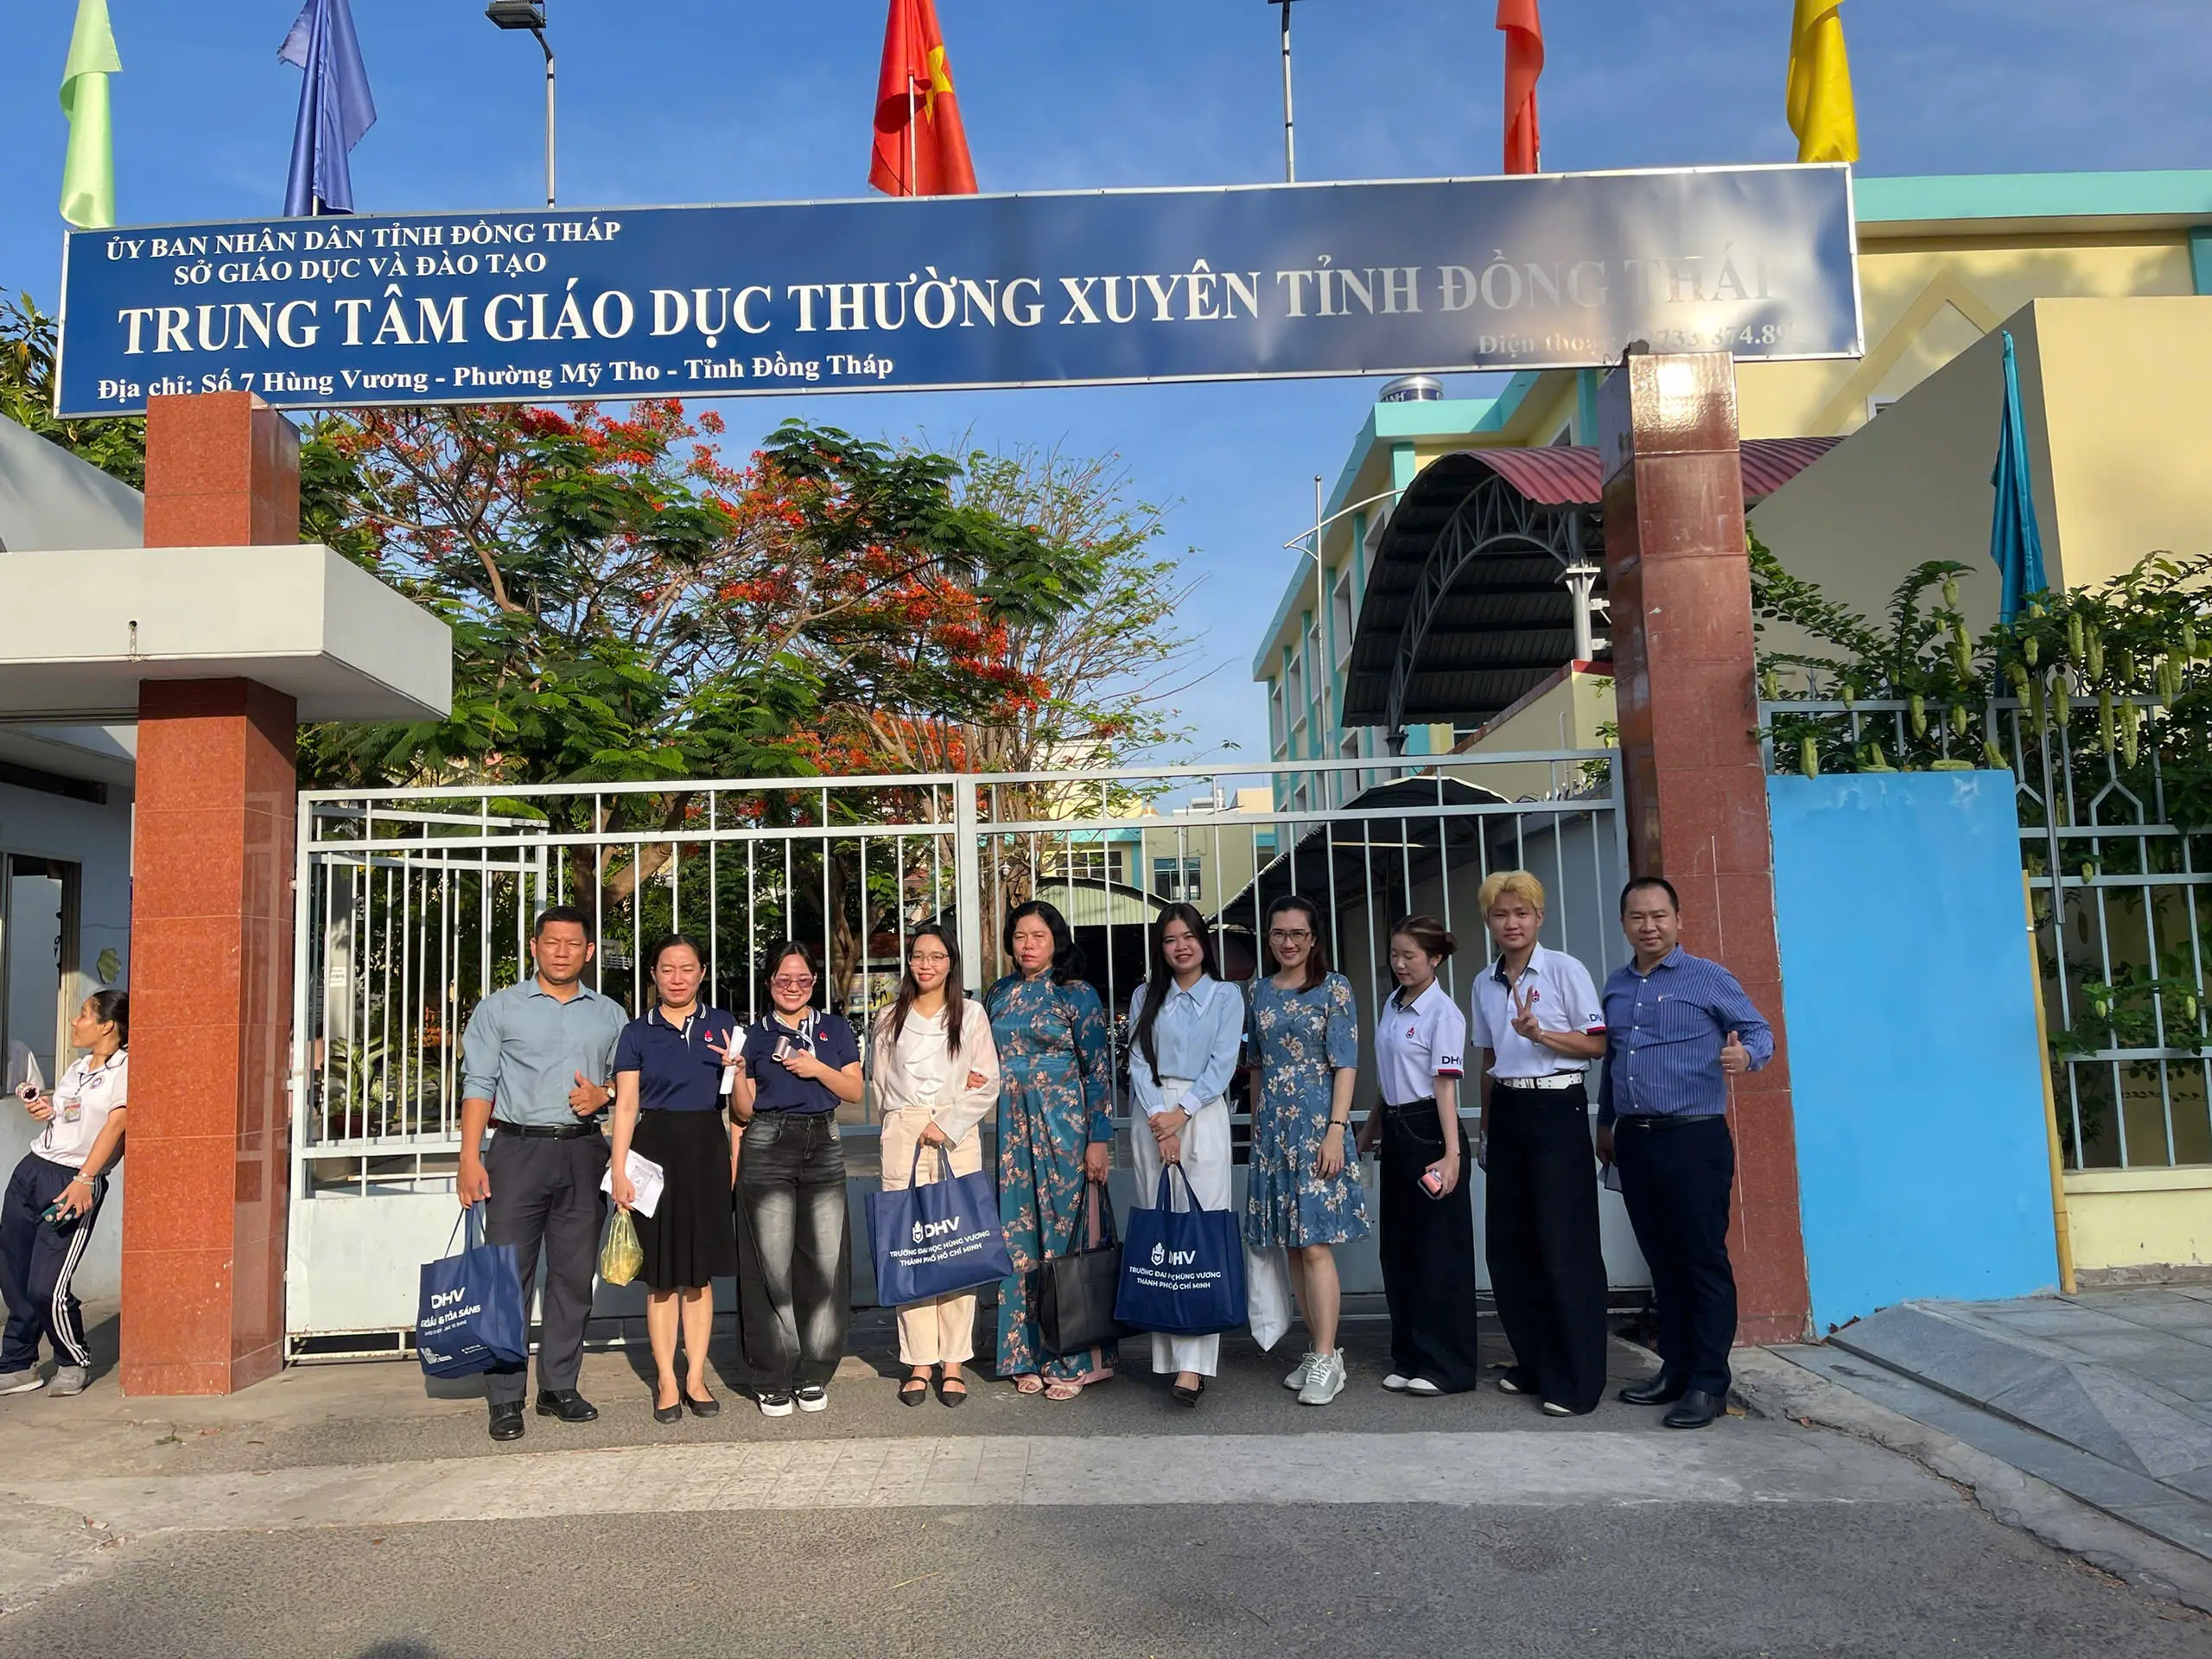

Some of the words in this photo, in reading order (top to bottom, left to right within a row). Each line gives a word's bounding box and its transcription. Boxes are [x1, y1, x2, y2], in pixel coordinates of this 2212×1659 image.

[106, 236, 145, 261] ỦY
[149, 236, 208, 257] BAN
[214, 227, 296, 253] NHÂN
[304, 225, 364, 250] DÂN
[372, 222, 443, 247] TỈNH
[450, 219, 536, 245] ĐỒNG
[542, 217, 621, 242] THÁP
[174, 259, 213, 285] SỞ
[218, 256, 292, 283] GIÁO
[299, 258, 360, 283] DỤC
[367, 251, 409, 276] VÀ
[416, 250, 479, 276] ĐÀO
[485, 252, 547, 278] TẠO
[118, 300, 321, 355] TRUNG
[334, 283, 468, 346] TÂM
[483, 277, 635, 342] GIÁO
[650, 285, 772, 348] DỤC
[787, 266, 1045, 333] THƯỜNG
[1058, 258, 1260, 326] XUYÊN
[1277, 255, 1424, 319] TỈNH
[1438, 249, 1610, 313] ĐỒNG
[98, 378, 140, 404] Địa
[239, 372, 255, 391] 7
[263, 370, 334, 396] Hùng
[340, 369, 429, 391] Vương
[453, 365, 552, 390] Phường
[560, 362, 603, 387] Mỹ
[609, 360, 660, 381] Tho
[684, 359, 744, 380] Tỉnh
[752, 351, 819, 381] Đồng
[827, 353, 893, 378] Tháp
[925, 1216, 960, 1238] DHV
[943, 1239, 964, 1249] HÙNG
[963, 1243, 982, 1254] MINH
[431, 1287, 466, 1309] DHV
[458, 1304, 481, 1318] SÁNG
